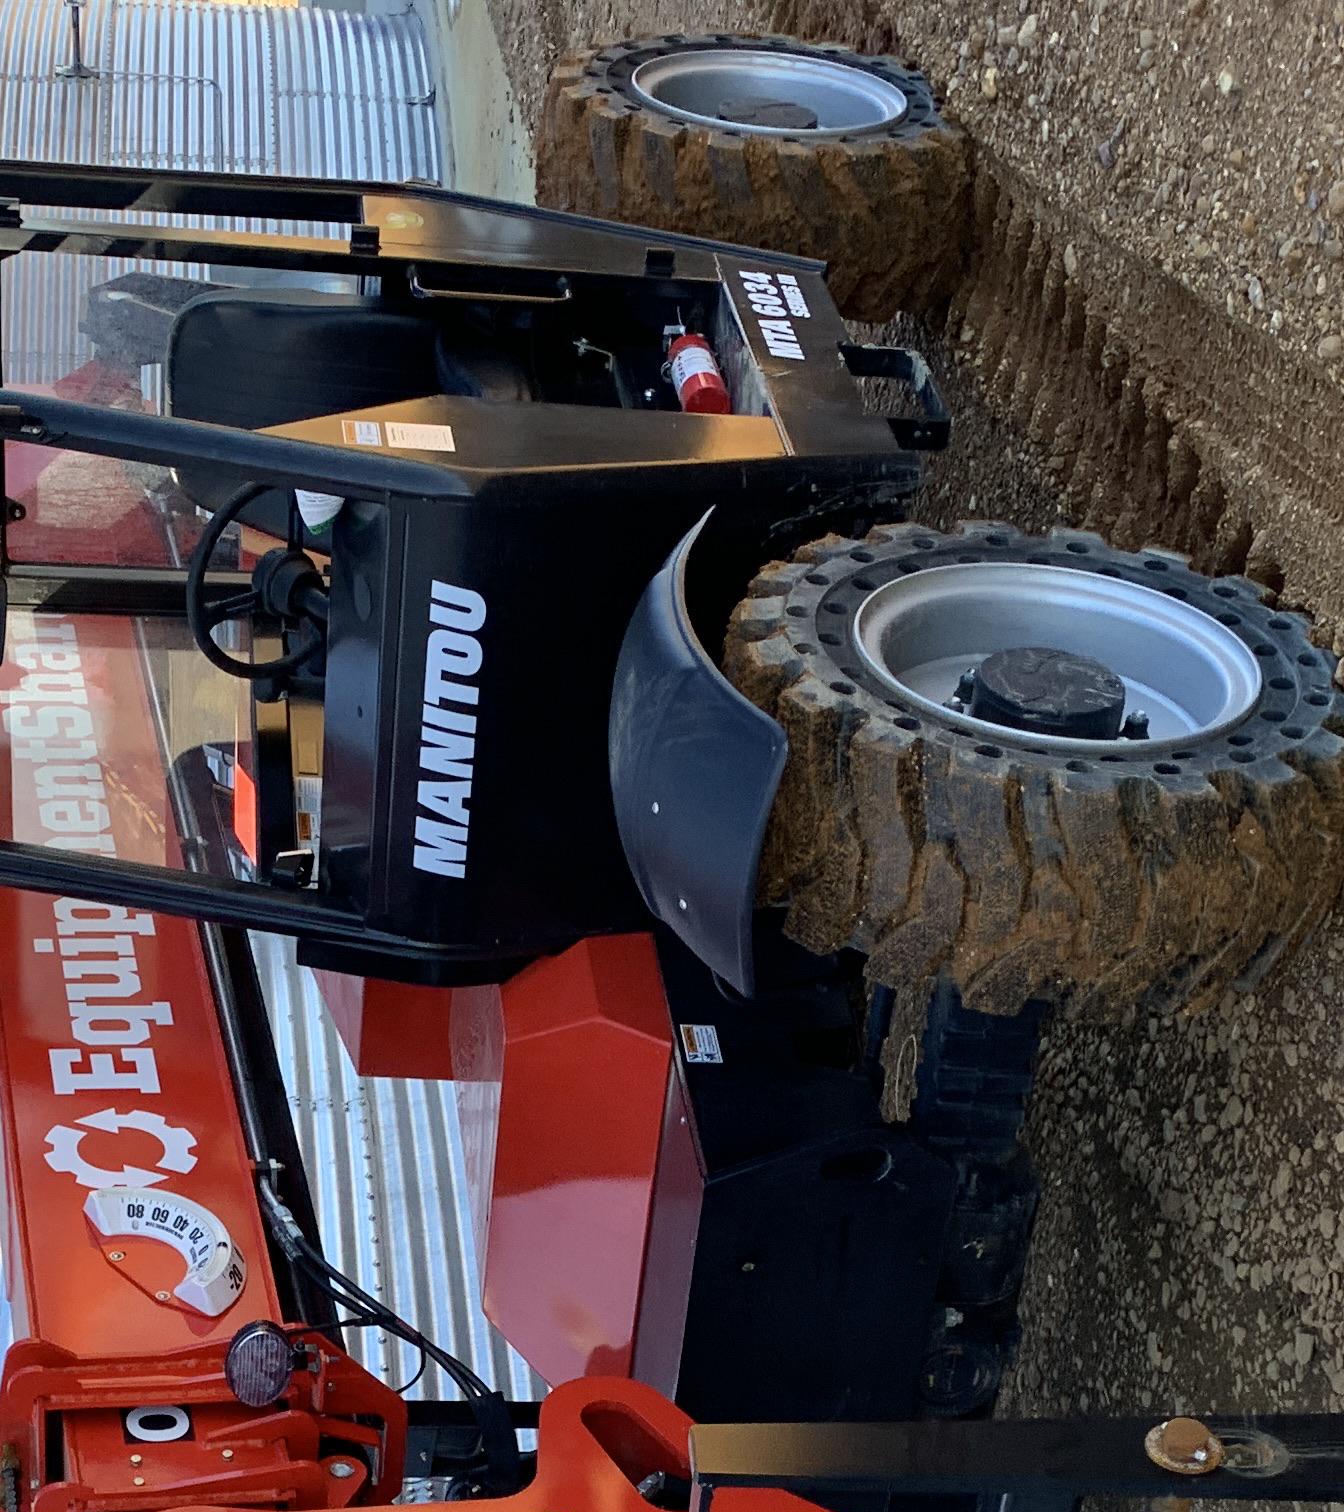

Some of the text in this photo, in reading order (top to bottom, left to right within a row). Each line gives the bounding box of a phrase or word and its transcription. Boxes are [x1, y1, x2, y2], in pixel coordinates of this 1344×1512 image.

[780, 285, 811, 318] SERIES
[739, 270, 805, 360] MTA 6034
[413, 580, 487, 879] MANITOU
[0, 613, 173, 1095] EquipentShar
[126, 1203, 145, 1219] 80
[150, 1207, 170, 1223] 60
[172, 1215, 190, 1232] 40
[188, 1227, 204, 1244] 20
